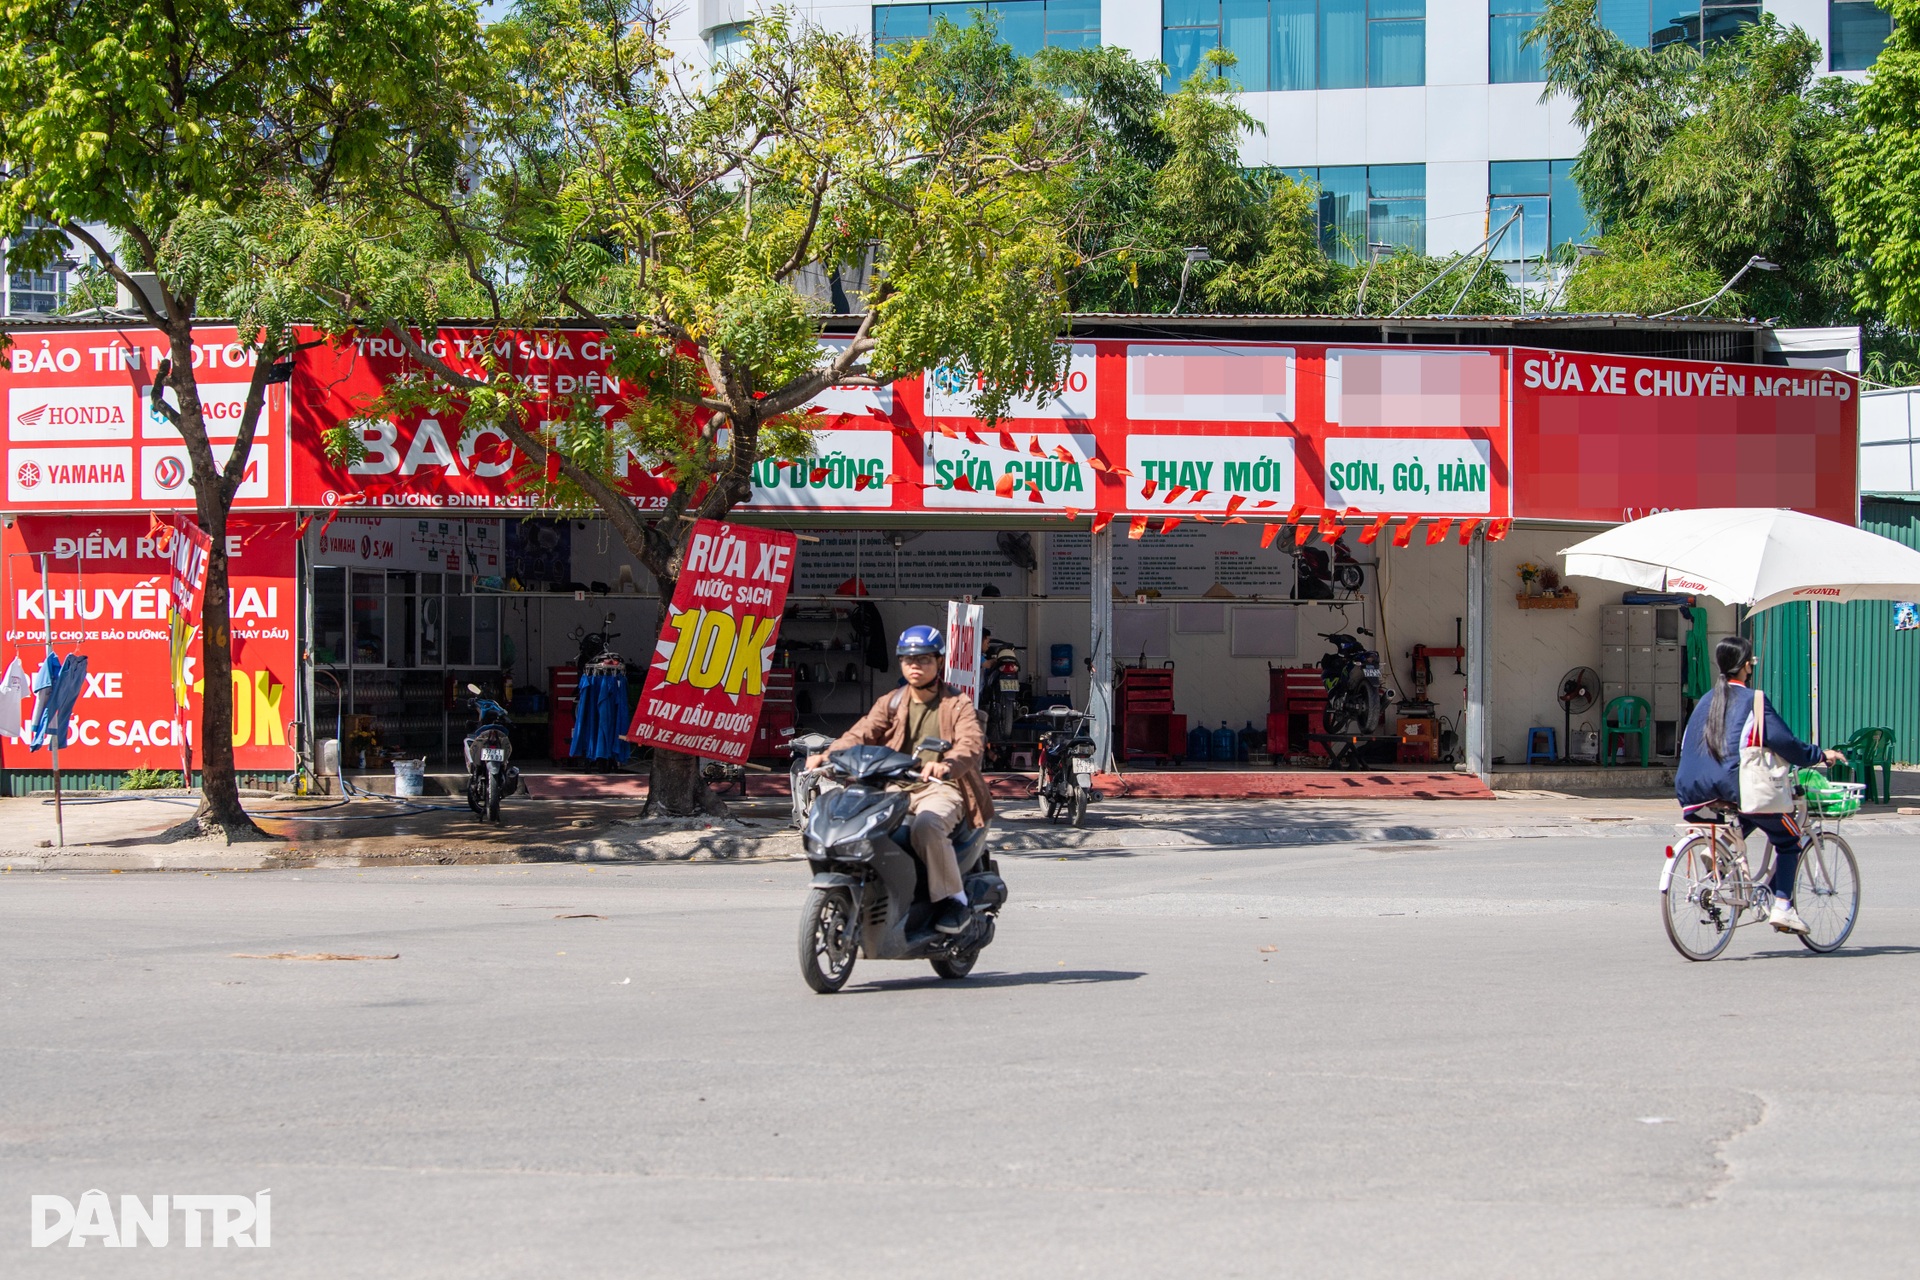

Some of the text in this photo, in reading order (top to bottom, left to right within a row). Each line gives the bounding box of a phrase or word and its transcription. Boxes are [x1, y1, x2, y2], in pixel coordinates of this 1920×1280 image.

[12, 339, 81, 373] BẢO
[89, 340, 141, 371] TÍN
[350, 338, 447, 358] TRUG
[454, 335, 511, 359] TÂM
[519, 334, 574, 360] SỬA
[1523, 351, 1583, 392] SỬA
[1590, 365, 1626, 394] XE
[1634, 366, 1745, 397] CHUYÊN
[49, 406, 125, 425] HONDA
[48, 464, 125, 483] YAMAHA
[790, 451, 884, 489] DƯỠNG
[935, 449, 1083, 492] SỬA CHỮA
[1141, 455, 1281, 492] THAY MỚI
[1329, 456, 1486, 495] SƠN, GÒ, HÀN
[447, 491, 490, 506] ĐÌNH
[54, 529, 127, 559] ĐIỂM
[330, 537, 355, 553] YAMAHA
[687, 525, 791, 584] RỬA XE
[228, 587, 278, 627] ẠI
[694, 579, 772, 607] NƯỚC SẠCH
[1805, 587, 1841, 596] HONDA
[27, 630, 58, 642] DỤNG
[62, 631, 83, 640] CHO
[85, 631, 99, 640] XE
[101, 628, 124, 640] BẢO
[127, 628, 169, 641] DƯỠNG,
[232, 630, 259, 639] THAY
[262, 627, 289, 640] DẦU)
[665, 608, 776, 696] 10K
[83, 672, 123, 698] XE
[11, 714, 193, 753] NỚC SẠCH
[680, 702, 713, 727] DẦU
[713, 712, 753, 735] ĐƯỢC
[654, 728, 673, 742] XE
[671, 733, 721, 752] KHUYẾN
[719, 740, 746, 759] MẠI
